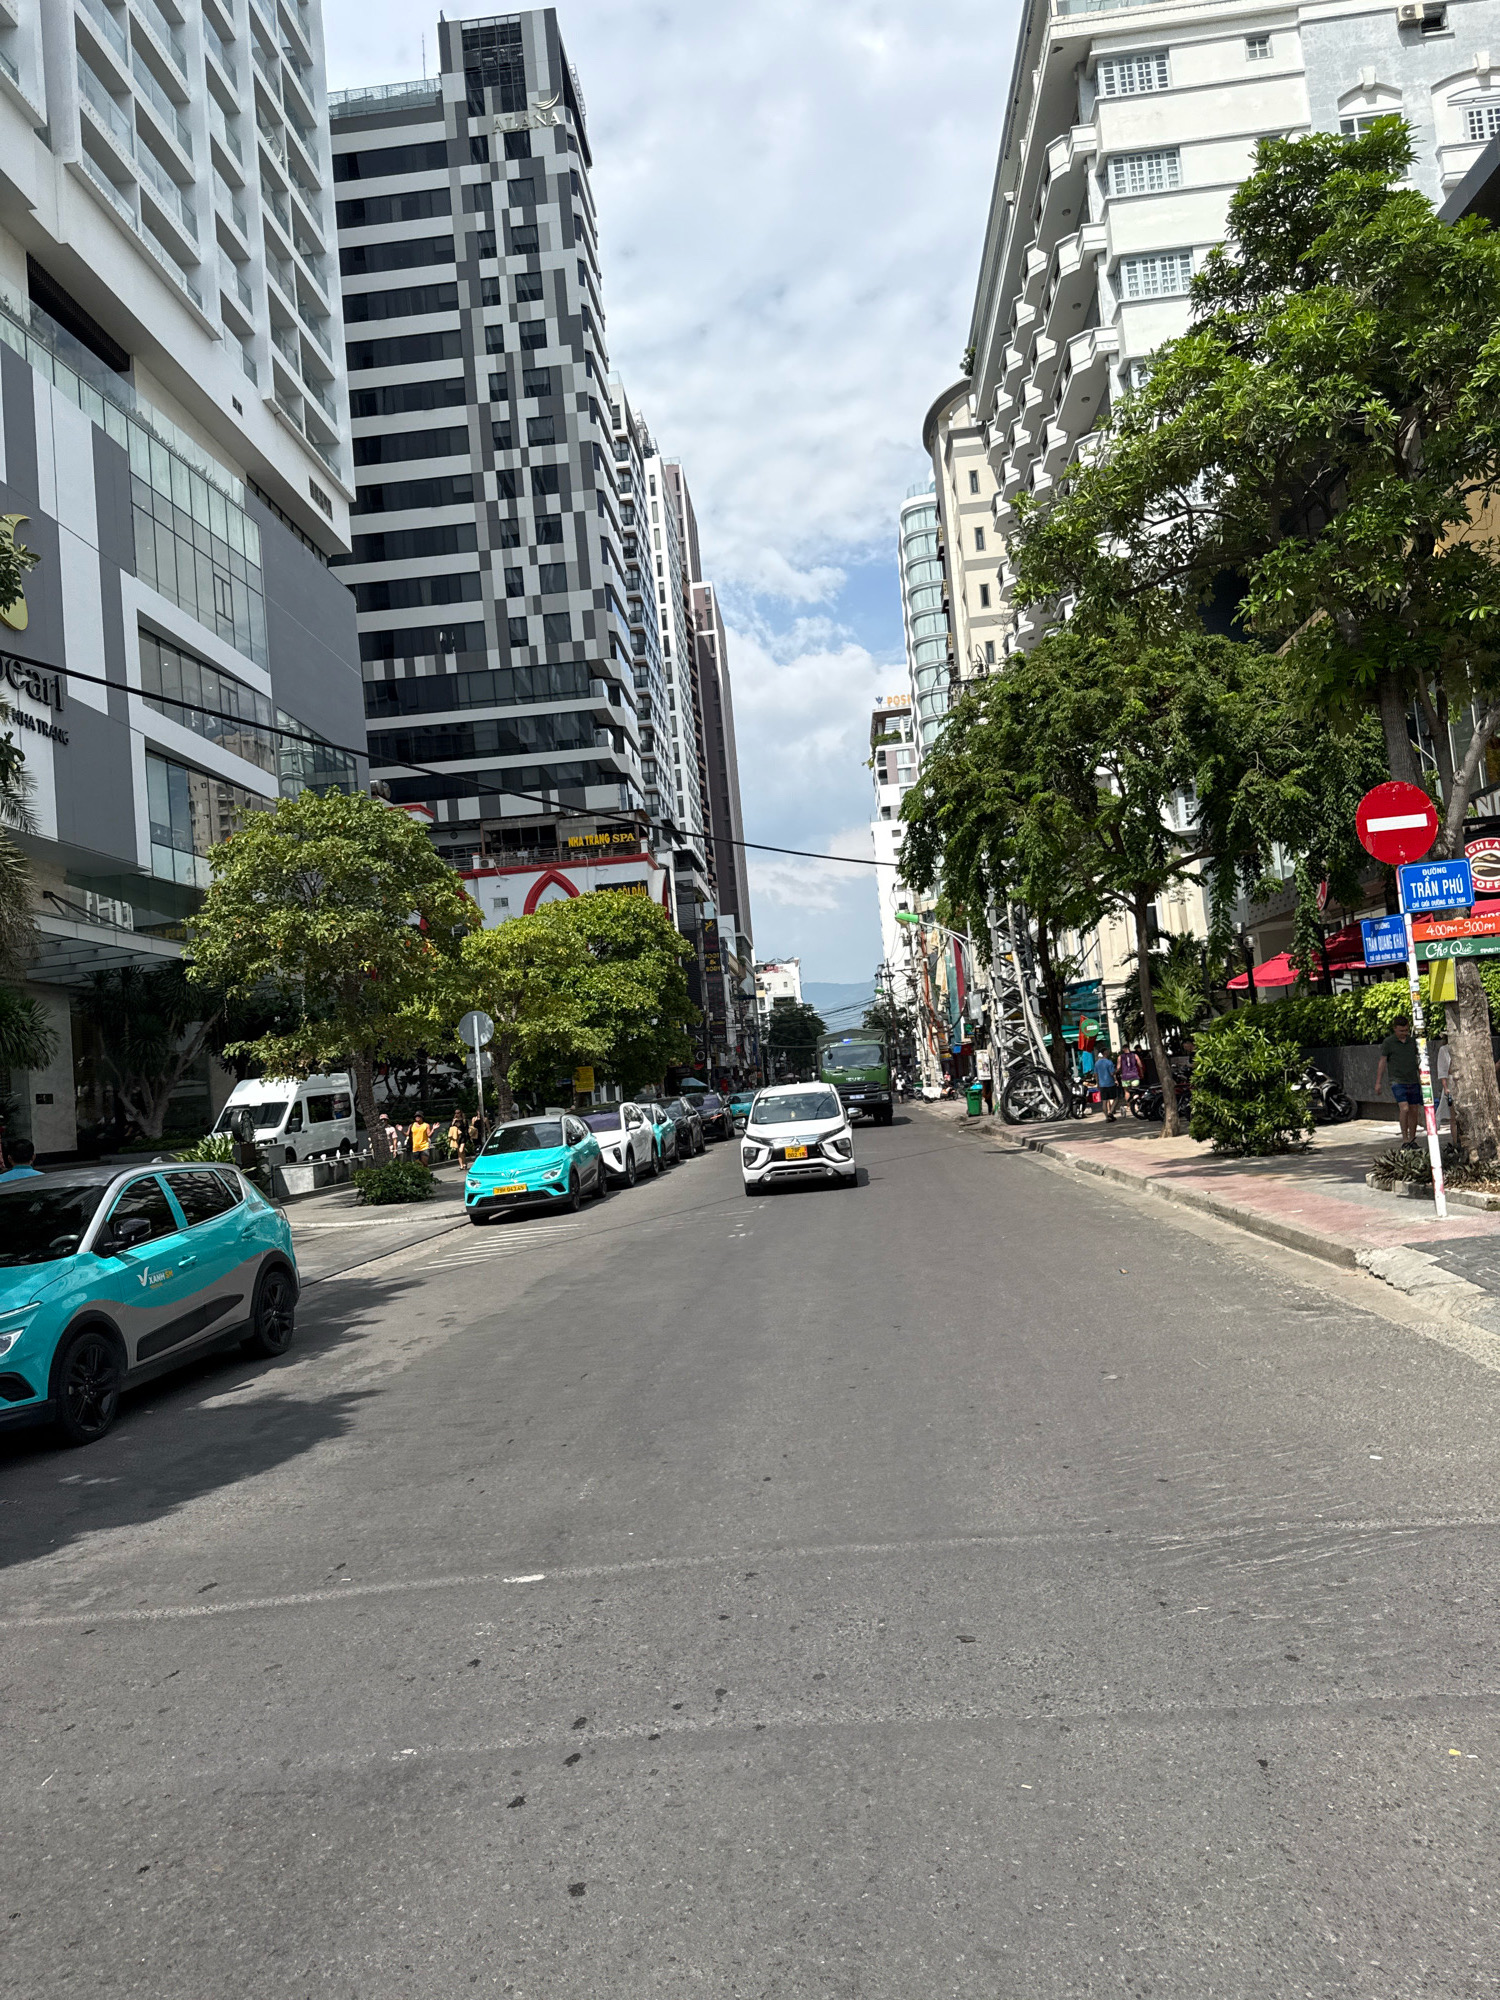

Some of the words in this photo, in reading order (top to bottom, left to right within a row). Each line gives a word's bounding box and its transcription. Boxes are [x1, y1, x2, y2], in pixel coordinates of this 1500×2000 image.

[492, 112, 561, 134] ALANA
[36, 718, 69, 745] TRANG
[568, 836, 584, 848] NHA
[584, 833, 611, 846] TRANG
[612, 832, 636, 843] SPA
[1410, 876, 1439, 899] TRẦN
[1442, 874, 1464, 895] PHÚ
[1425, 943, 1448, 958] Chợ
[1450, 941, 1475, 955] Quê
[149, 1272, 165, 1284] XANH
